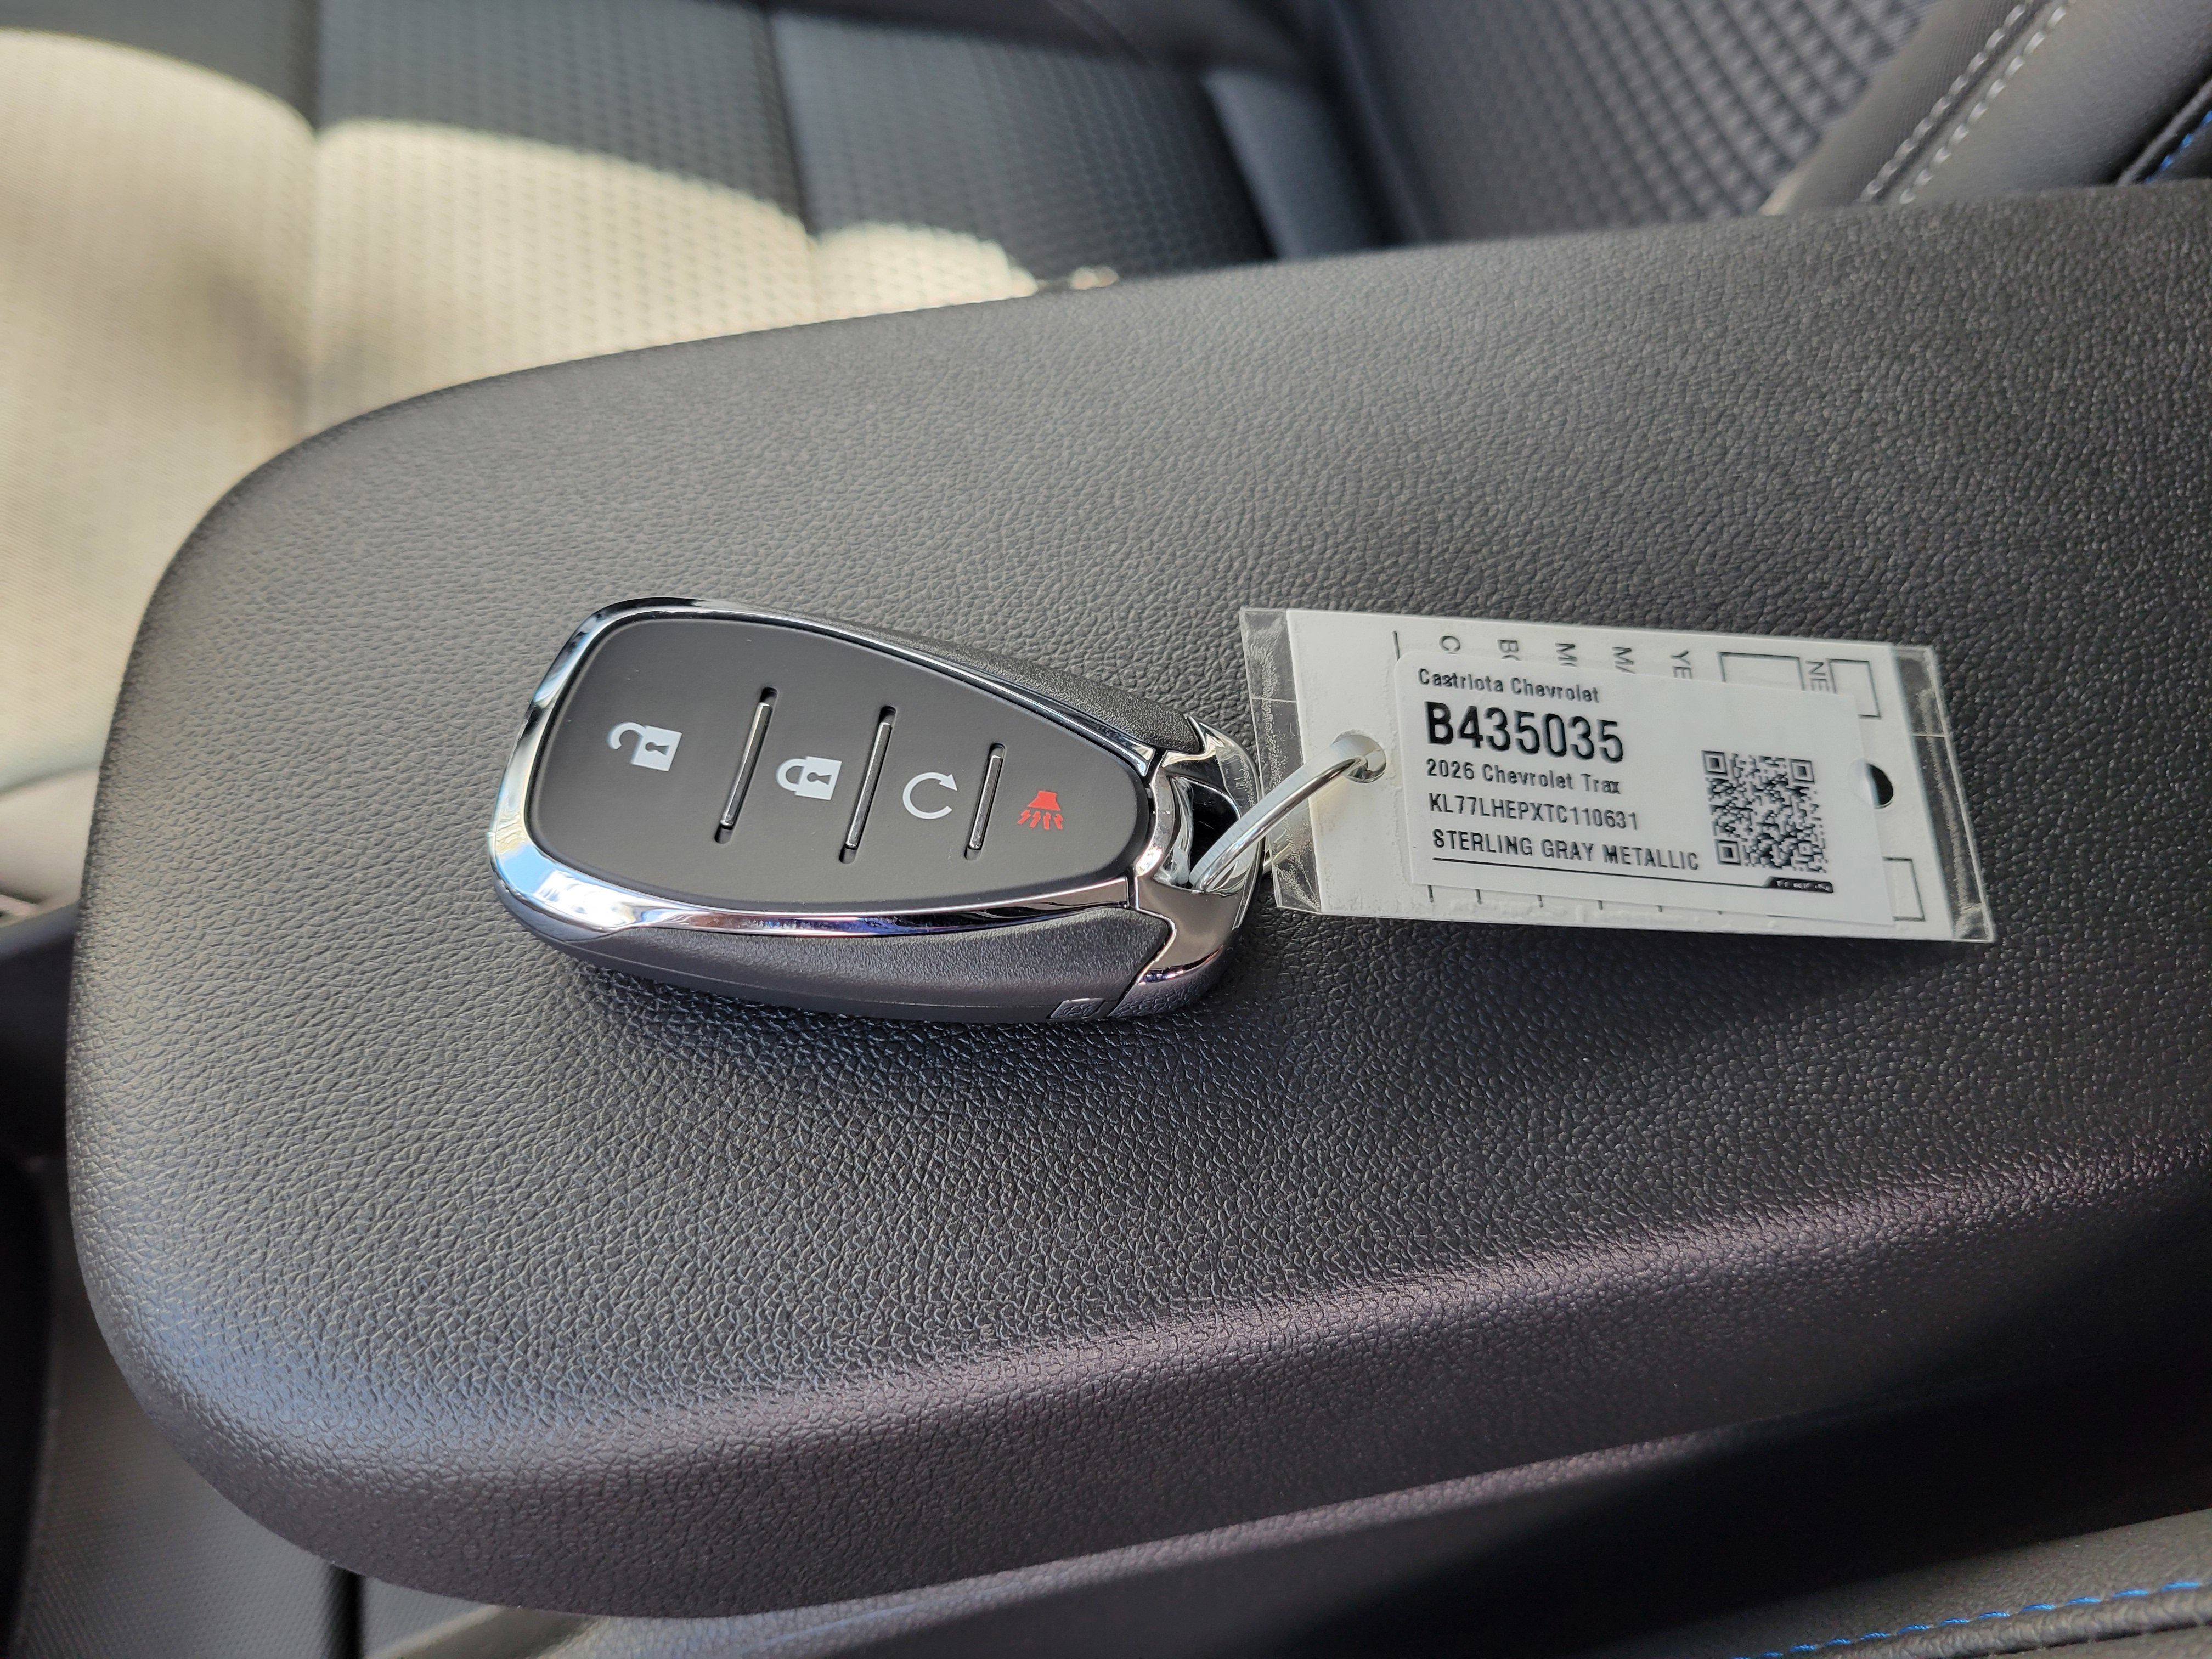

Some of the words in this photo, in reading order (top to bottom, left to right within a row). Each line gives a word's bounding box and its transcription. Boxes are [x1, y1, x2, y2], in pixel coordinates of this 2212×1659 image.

[1439, 635, 1461, 654] C
[1497, 639, 1521, 661] B
[1555, 642, 1578, 667] M
[1510, 677, 1600, 703] Chevrolet
[1424, 701, 1624, 764] B435035
[1426, 758, 1475, 780] 2026
[1482, 763, 1573, 790] Chevrolet
[1581, 773, 1621, 794] Trax
[1428, 792, 1638, 831] KL77LHEPXTC110631
[1432, 828, 1533, 857] STERLING
[1541, 838, 1594, 862] GRAY
[1601, 844, 1699, 871] METALLIC
